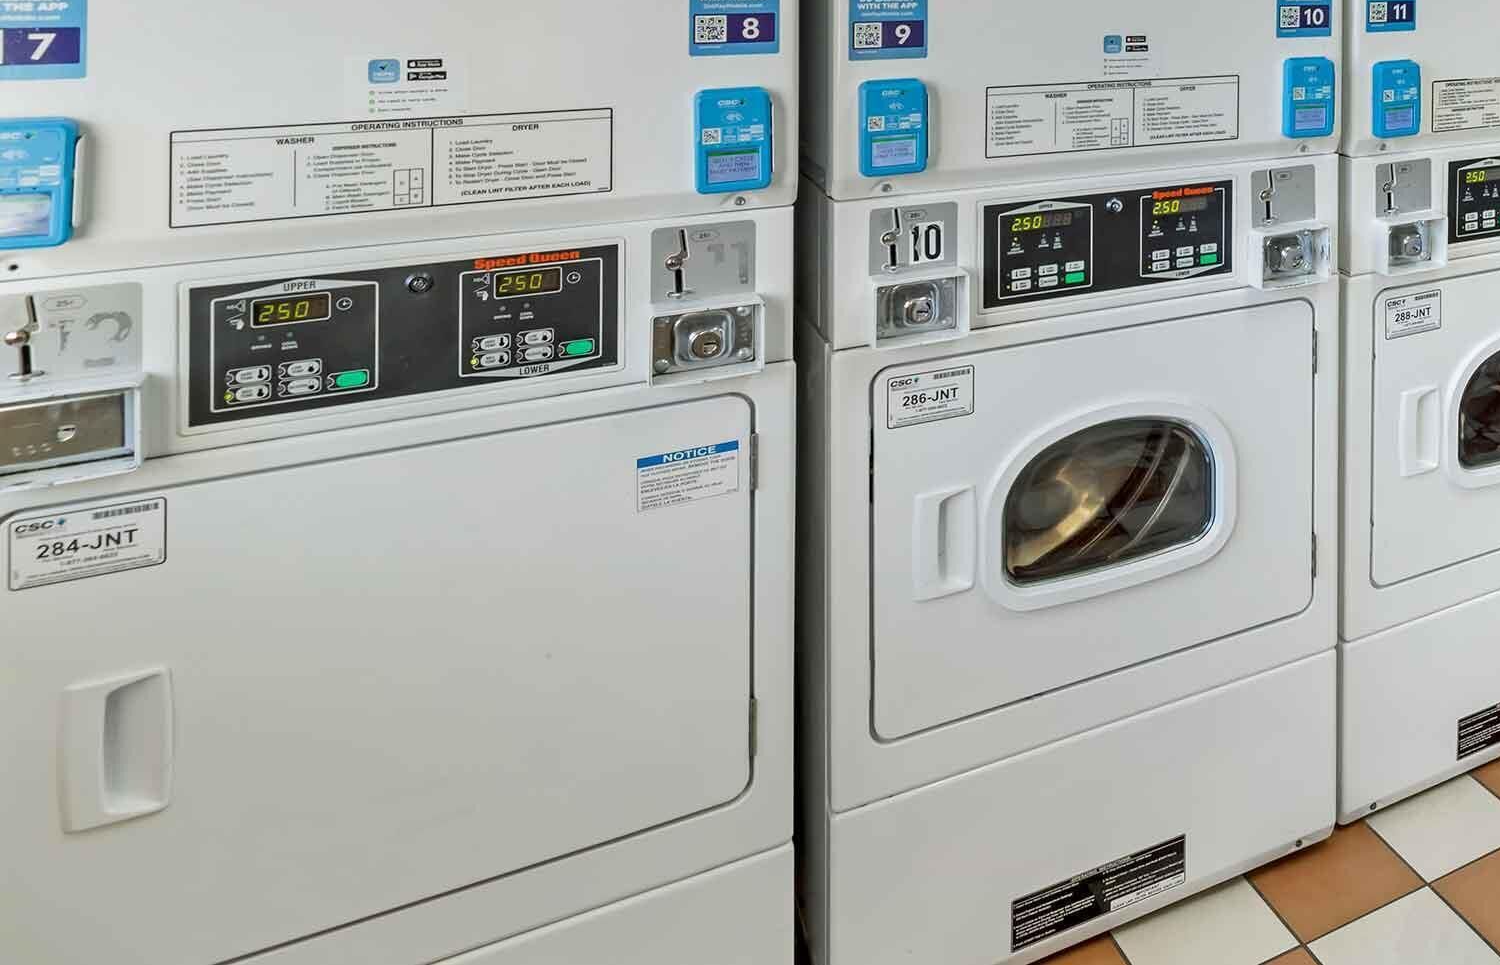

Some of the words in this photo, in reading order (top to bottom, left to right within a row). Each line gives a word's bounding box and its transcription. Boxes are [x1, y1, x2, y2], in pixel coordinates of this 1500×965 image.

[1304, 8, 1324, 25] 10
[1393, 4, 1406, 20] 11
[742, 17, 759, 39] 8
[895, 25, 911, 44] 9
[27, 33, 57, 61] 7
[352, 123, 400, 131] OPERATING
[402, 119, 463, 128] INSTRUCTIONS
[276, 137, 315, 145] WASHER
[474, 254, 526, 270] Speed
[529, 251, 580, 263] Queen
[283, 281, 316, 292] UPPER
[1395, 307, 1431, 323] 288-JNT
[519, 364, 550, 376] LOWER
[890, 379, 912, 388] CSC
[903, 388, 958, 407] 286-JNT
[663, 446, 717, 463] NOTICE
[15, 521, 54, 534] CSC
[36, 529, 138, 559] 284-JNT
